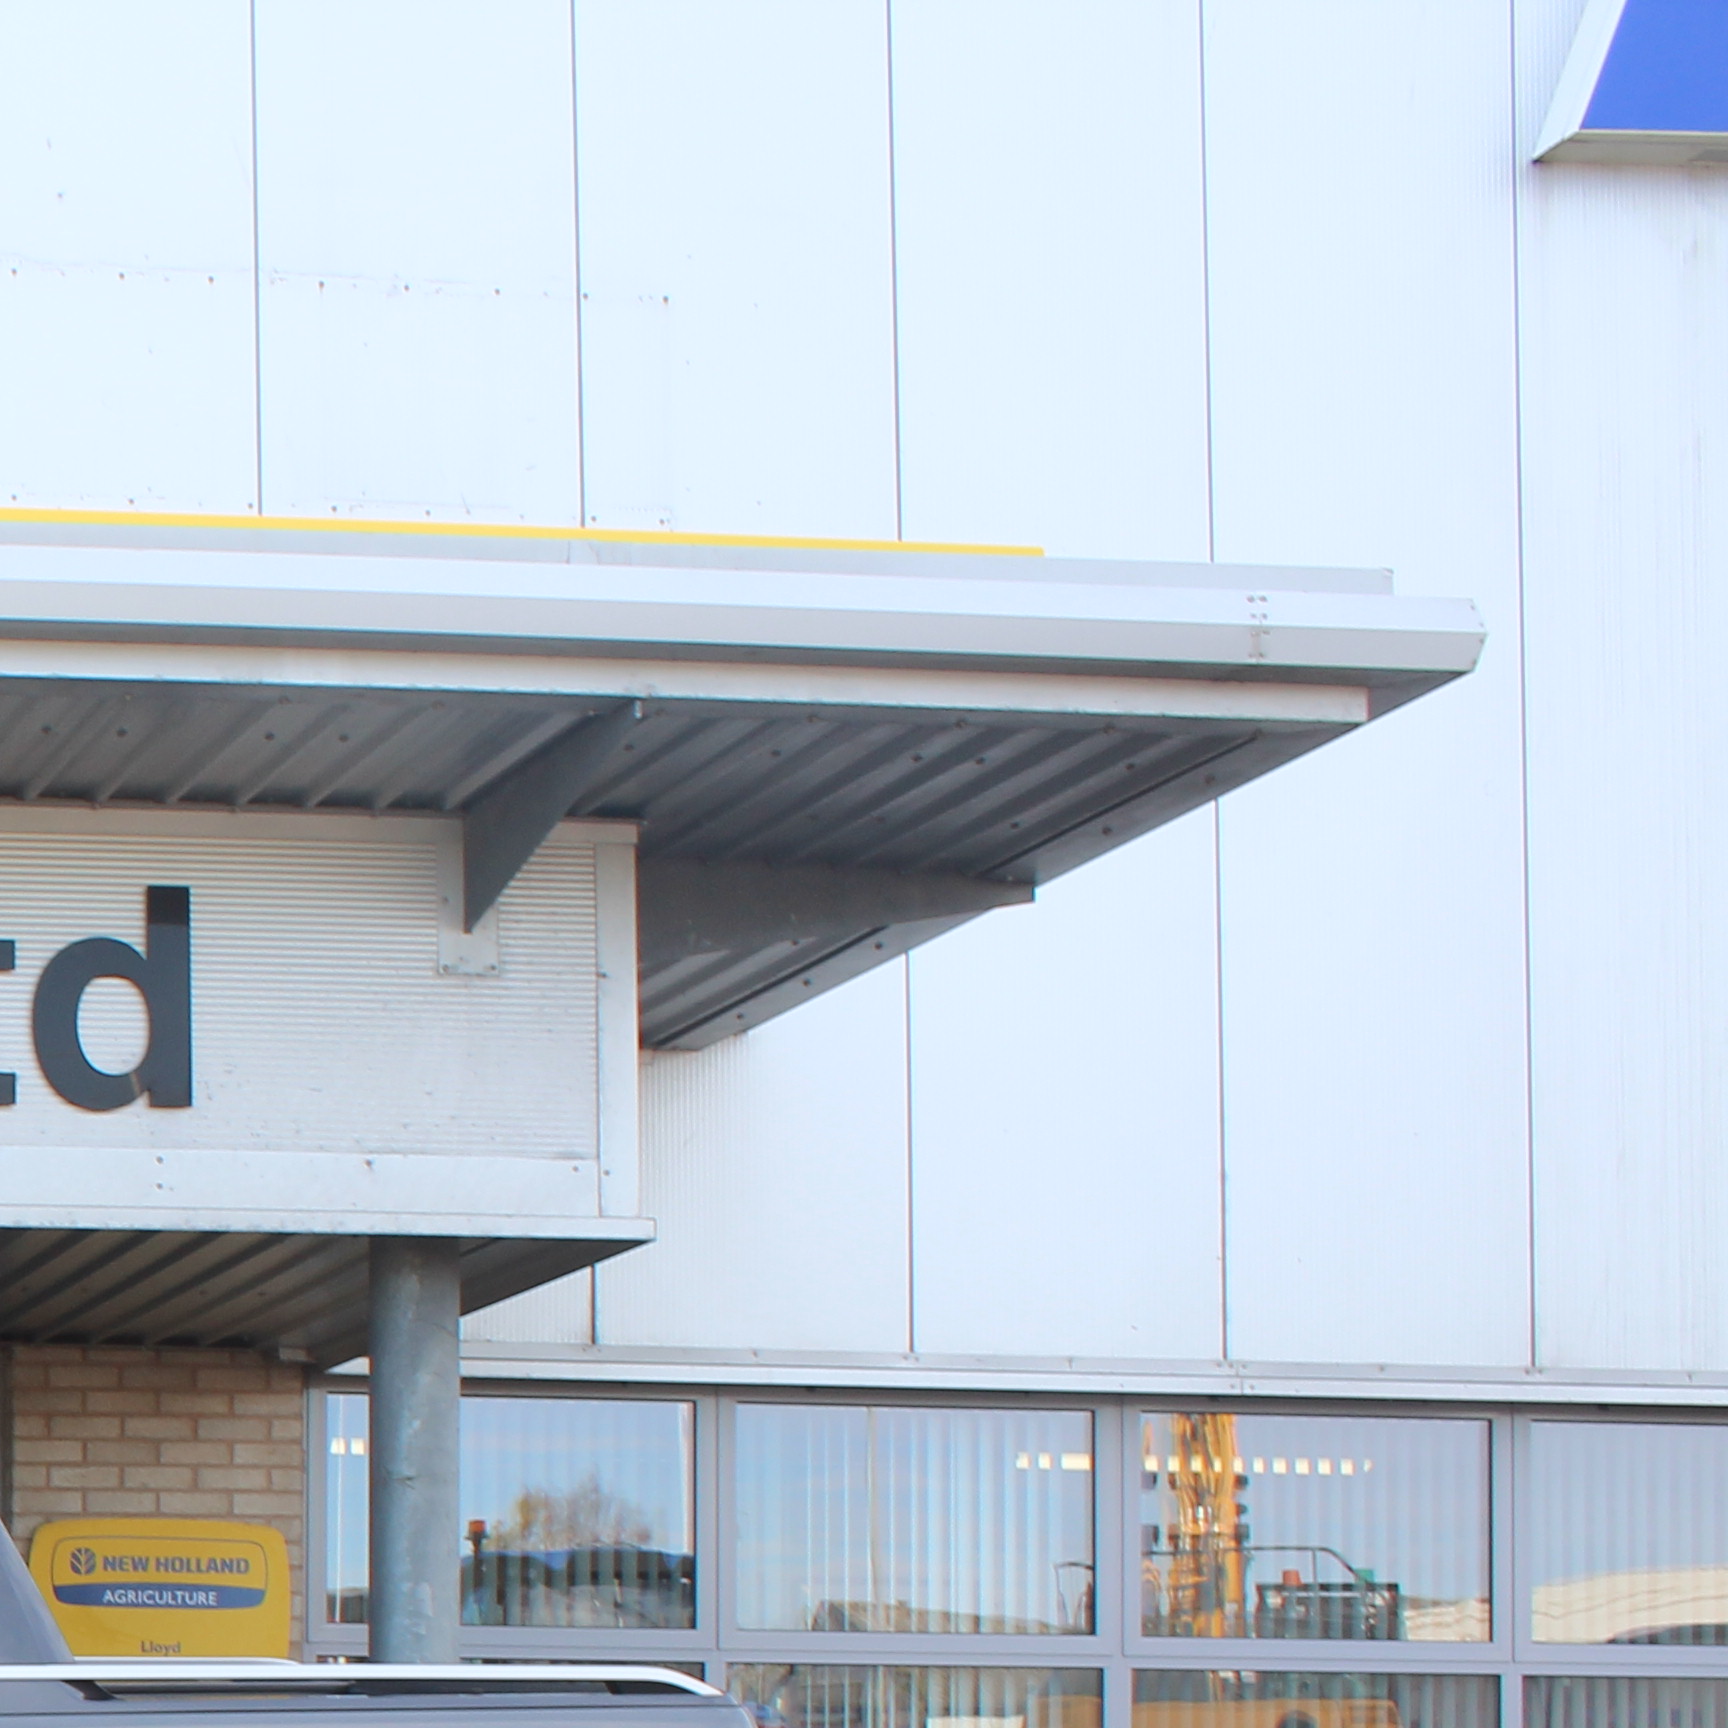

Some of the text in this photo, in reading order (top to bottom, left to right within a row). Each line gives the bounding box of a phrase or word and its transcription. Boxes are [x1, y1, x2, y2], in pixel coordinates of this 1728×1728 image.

[102, 1556, 250, 1575] NEW HOLLAND
[102, 1589, 218, 1607] AGRICULTURE
[141, 1641, 181, 1656] Lloyd
